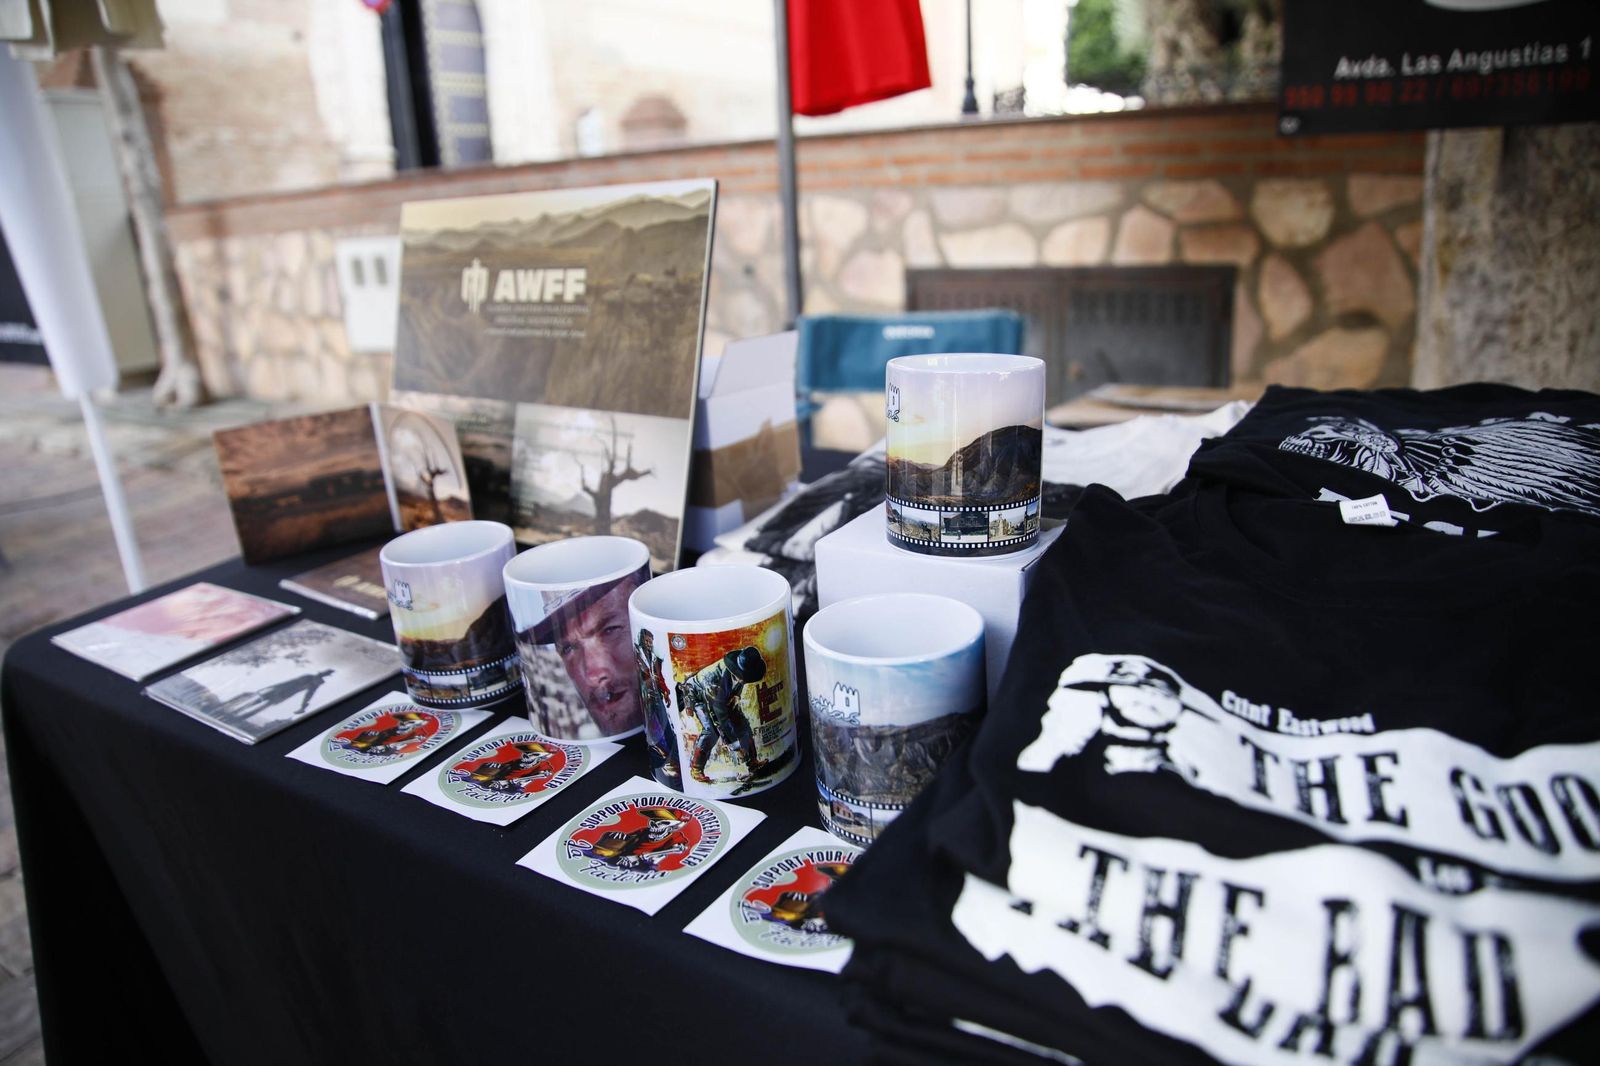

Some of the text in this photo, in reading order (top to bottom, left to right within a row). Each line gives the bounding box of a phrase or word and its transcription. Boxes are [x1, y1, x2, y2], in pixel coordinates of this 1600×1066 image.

[1401, 52, 1441, 76] Las
[1447, 42, 1569, 75] Angustias
[493, 268, 587, 303] AWFF
[461, 739, 506, 762] SUPPORT
[508, 733, 538, 744] YOUR
[1240, 734, 1409, 829] THE
[580, 800, 629, 829] SUPPORT
[632, 796, 665, 808] YOUR
[667, 797, 697, 814] LOCAL
[752, 854, 804, 889] SUPPORT
[806, 850, 842, 864] YOUR
[1079, 844, 1265, 981] THE
[1318, 898, 1525, 1043] BAD
